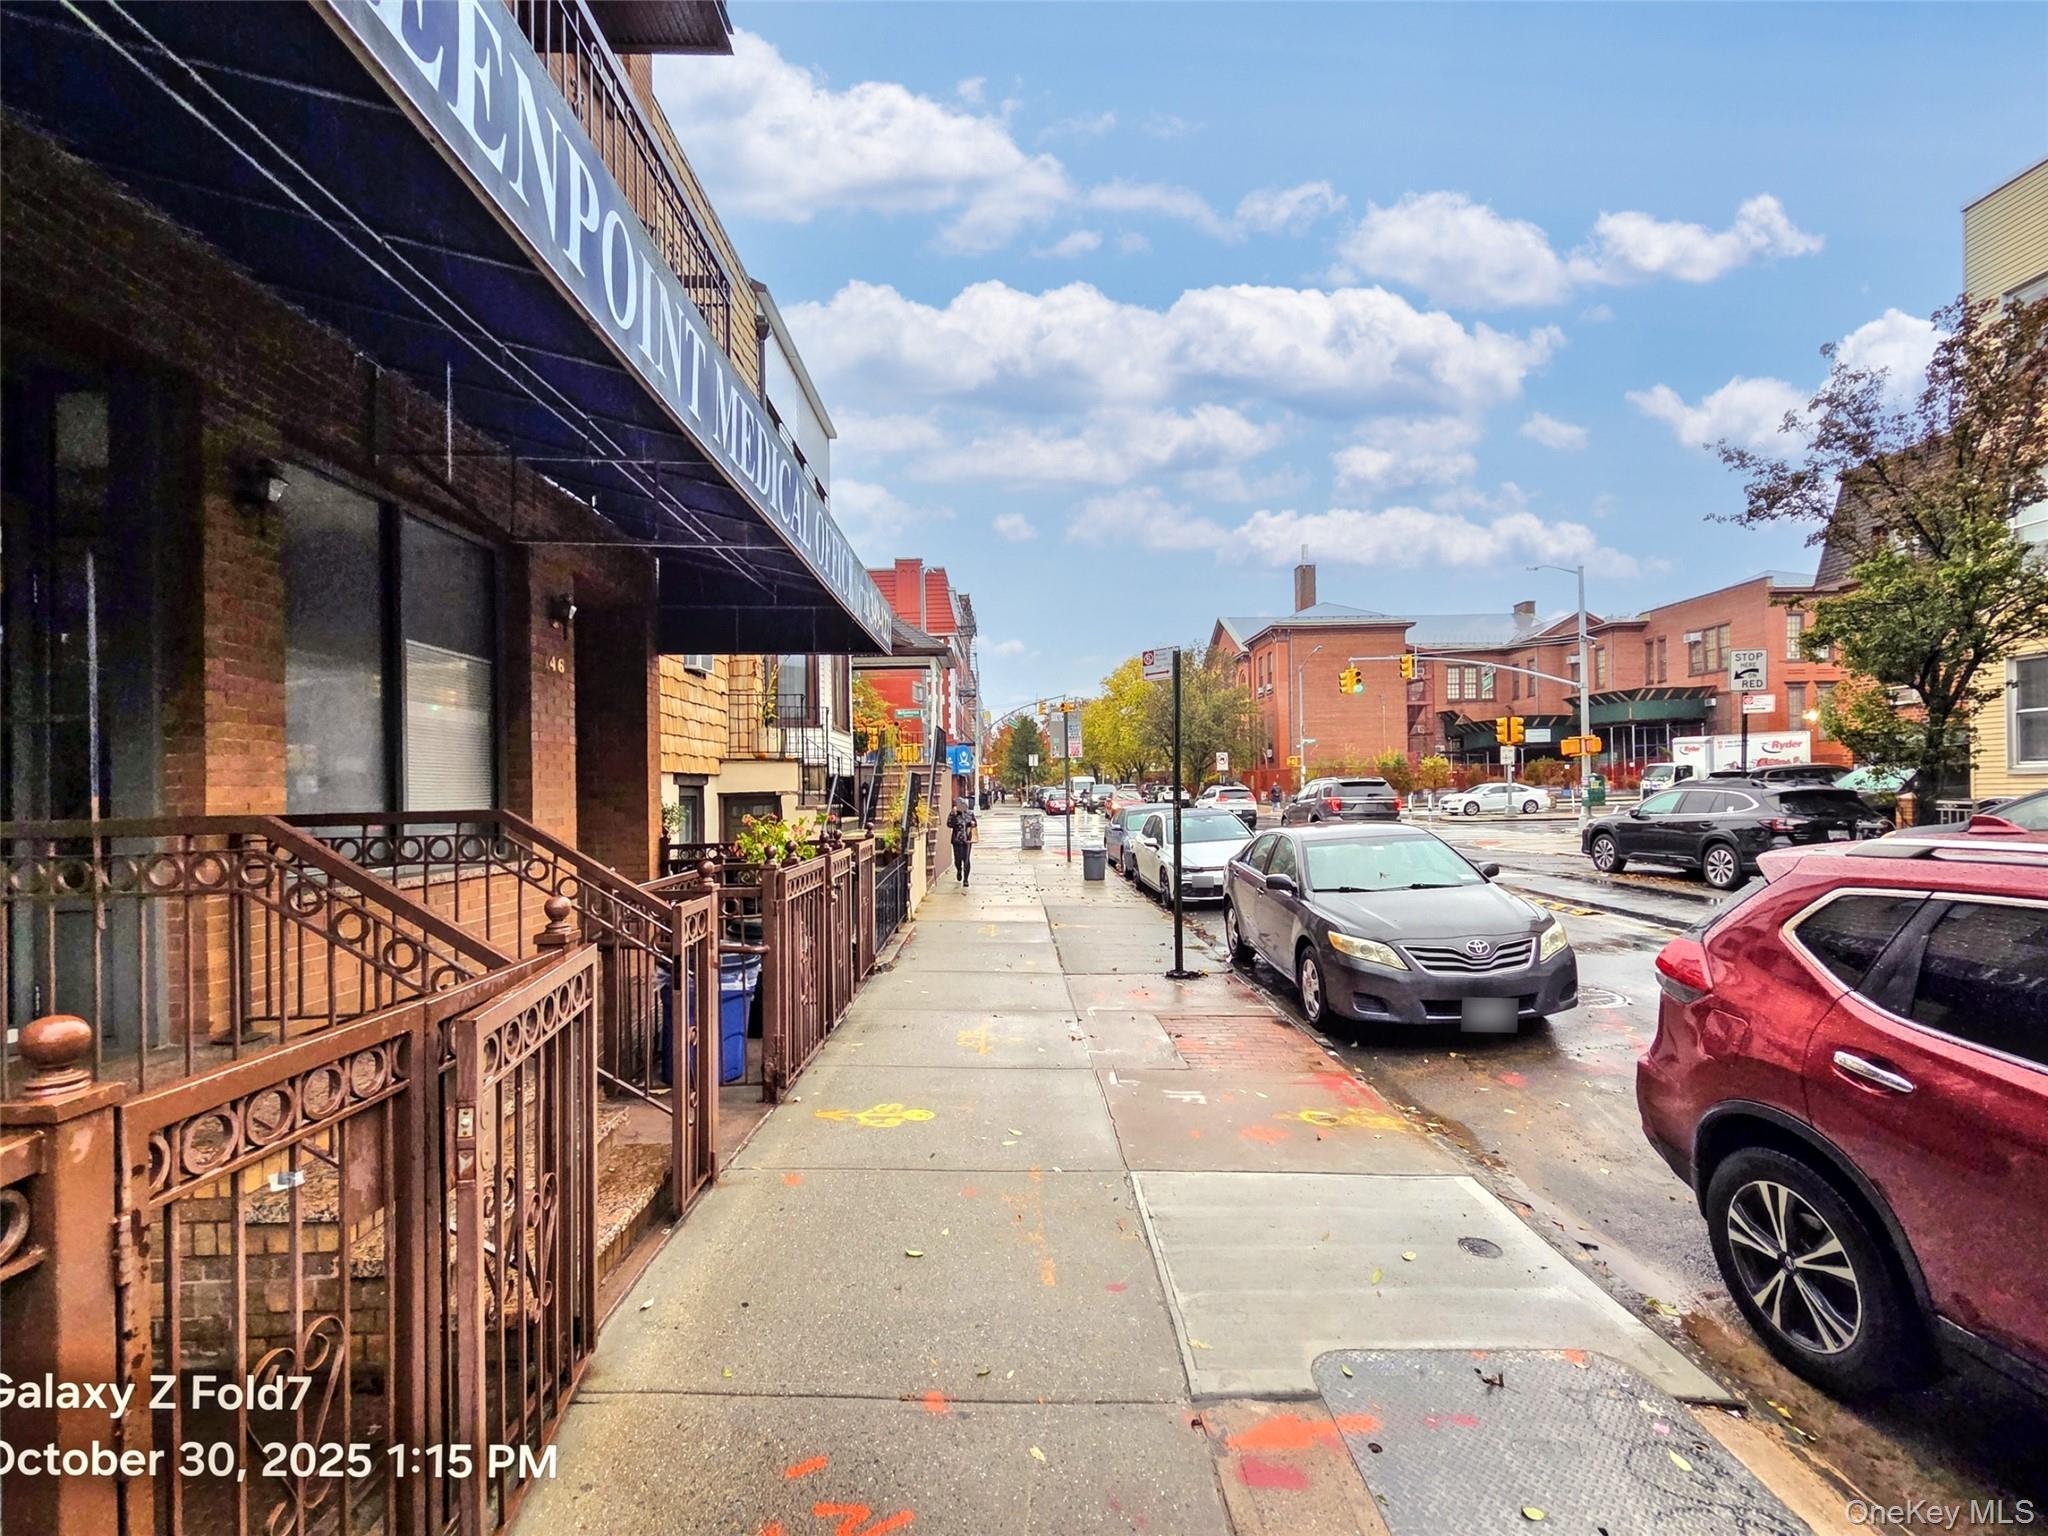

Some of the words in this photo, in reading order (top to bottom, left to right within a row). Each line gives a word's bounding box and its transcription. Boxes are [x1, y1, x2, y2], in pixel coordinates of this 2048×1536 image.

[713, 359, 811, 550] MEDICAL
[1735, 652, 1763, 661] STOP
[1742, 680, 1763, 688] RED
[1771, 740, 1803, 749] Ryder
